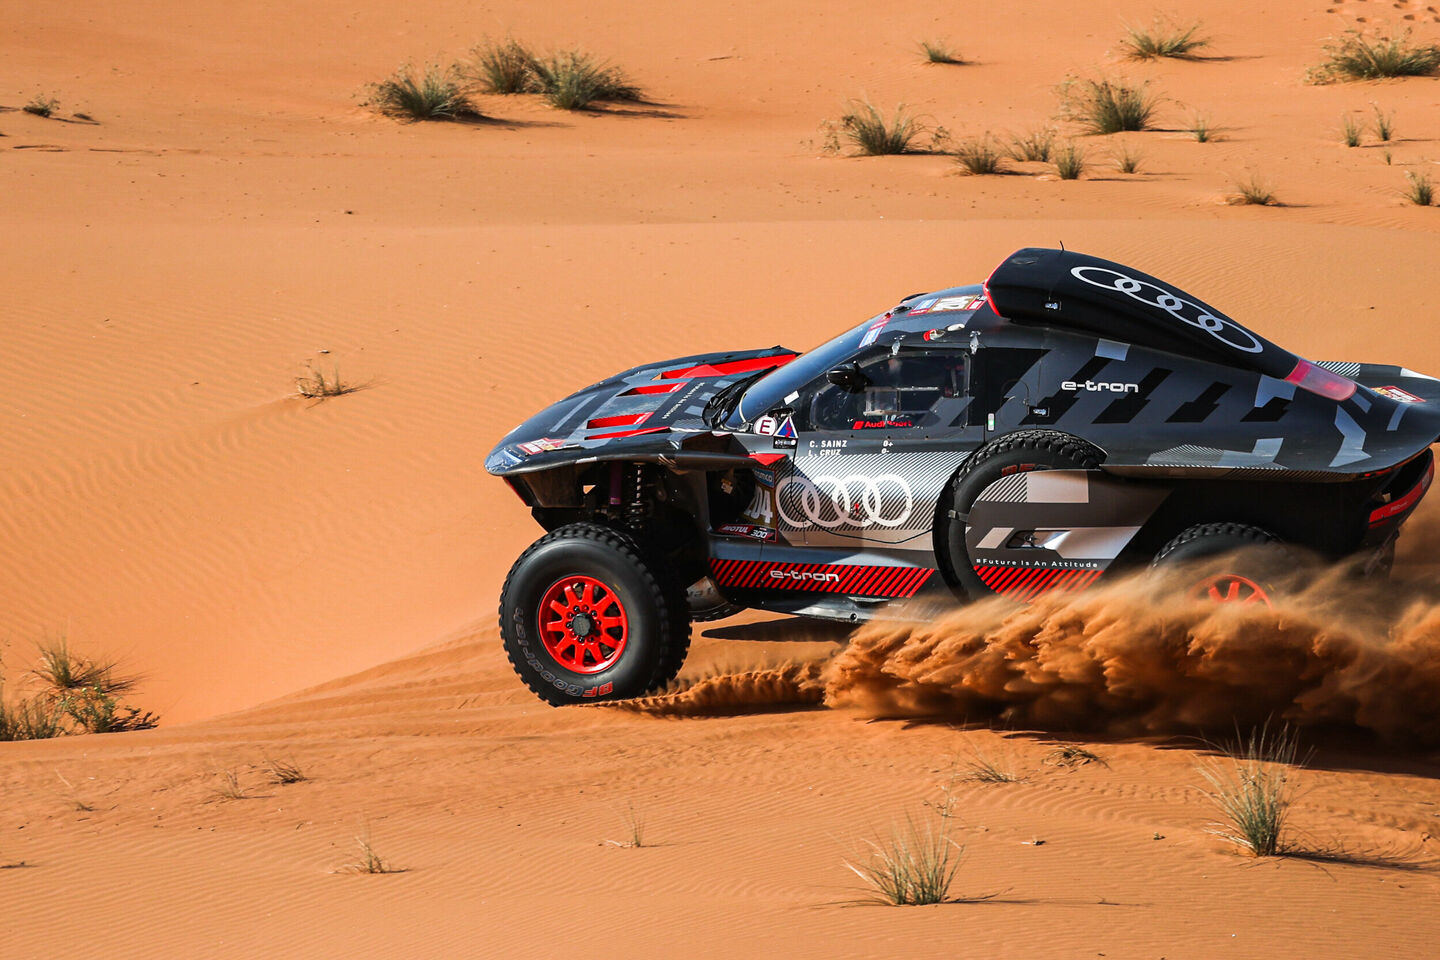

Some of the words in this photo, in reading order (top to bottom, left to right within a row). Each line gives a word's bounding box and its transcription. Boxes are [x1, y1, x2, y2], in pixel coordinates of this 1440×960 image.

[1061, 380, 1139, 393] e-tron
[760, 419, 772, 435] E
[864, 420, 885, 428] Audi
[821, 440, 848, 448] SAINZ
[819, 449, 842, 457] CRUZ
[721, 525, 749, 533] MOTUL
[770, 570, 840, 582] e-tron
